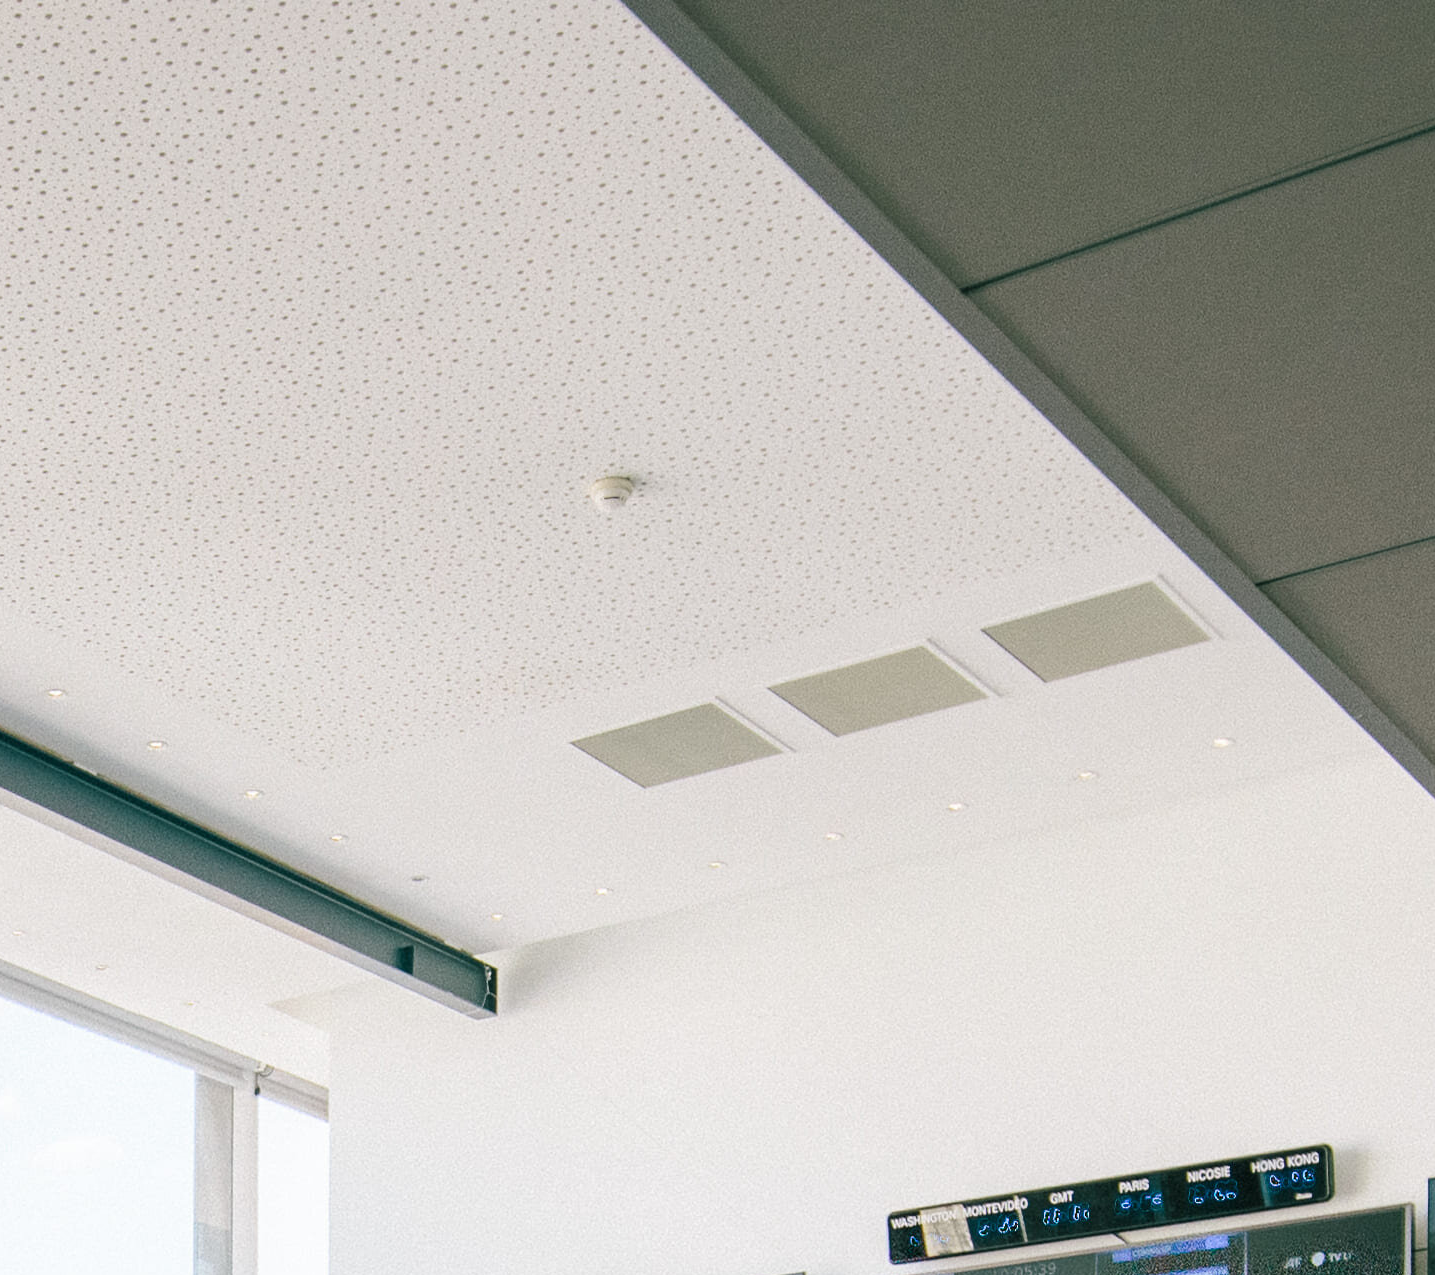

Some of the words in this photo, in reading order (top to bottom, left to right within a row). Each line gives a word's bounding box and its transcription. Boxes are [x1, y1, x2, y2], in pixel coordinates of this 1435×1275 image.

[1251, 1156, 1285, 1174] HONG
[1287, 1151, 1320, 1168] KONG
[1186, 1165, 1231, 1183] NICOSIE
[1118, 1178, 1150, 1194] PARIS
[1049, 1190, 1074, 1204] GMT
[963, 1196, 1029, 1218] MONTEVIDEO
[891, 1208, 957, 1229] WASHINGTON
